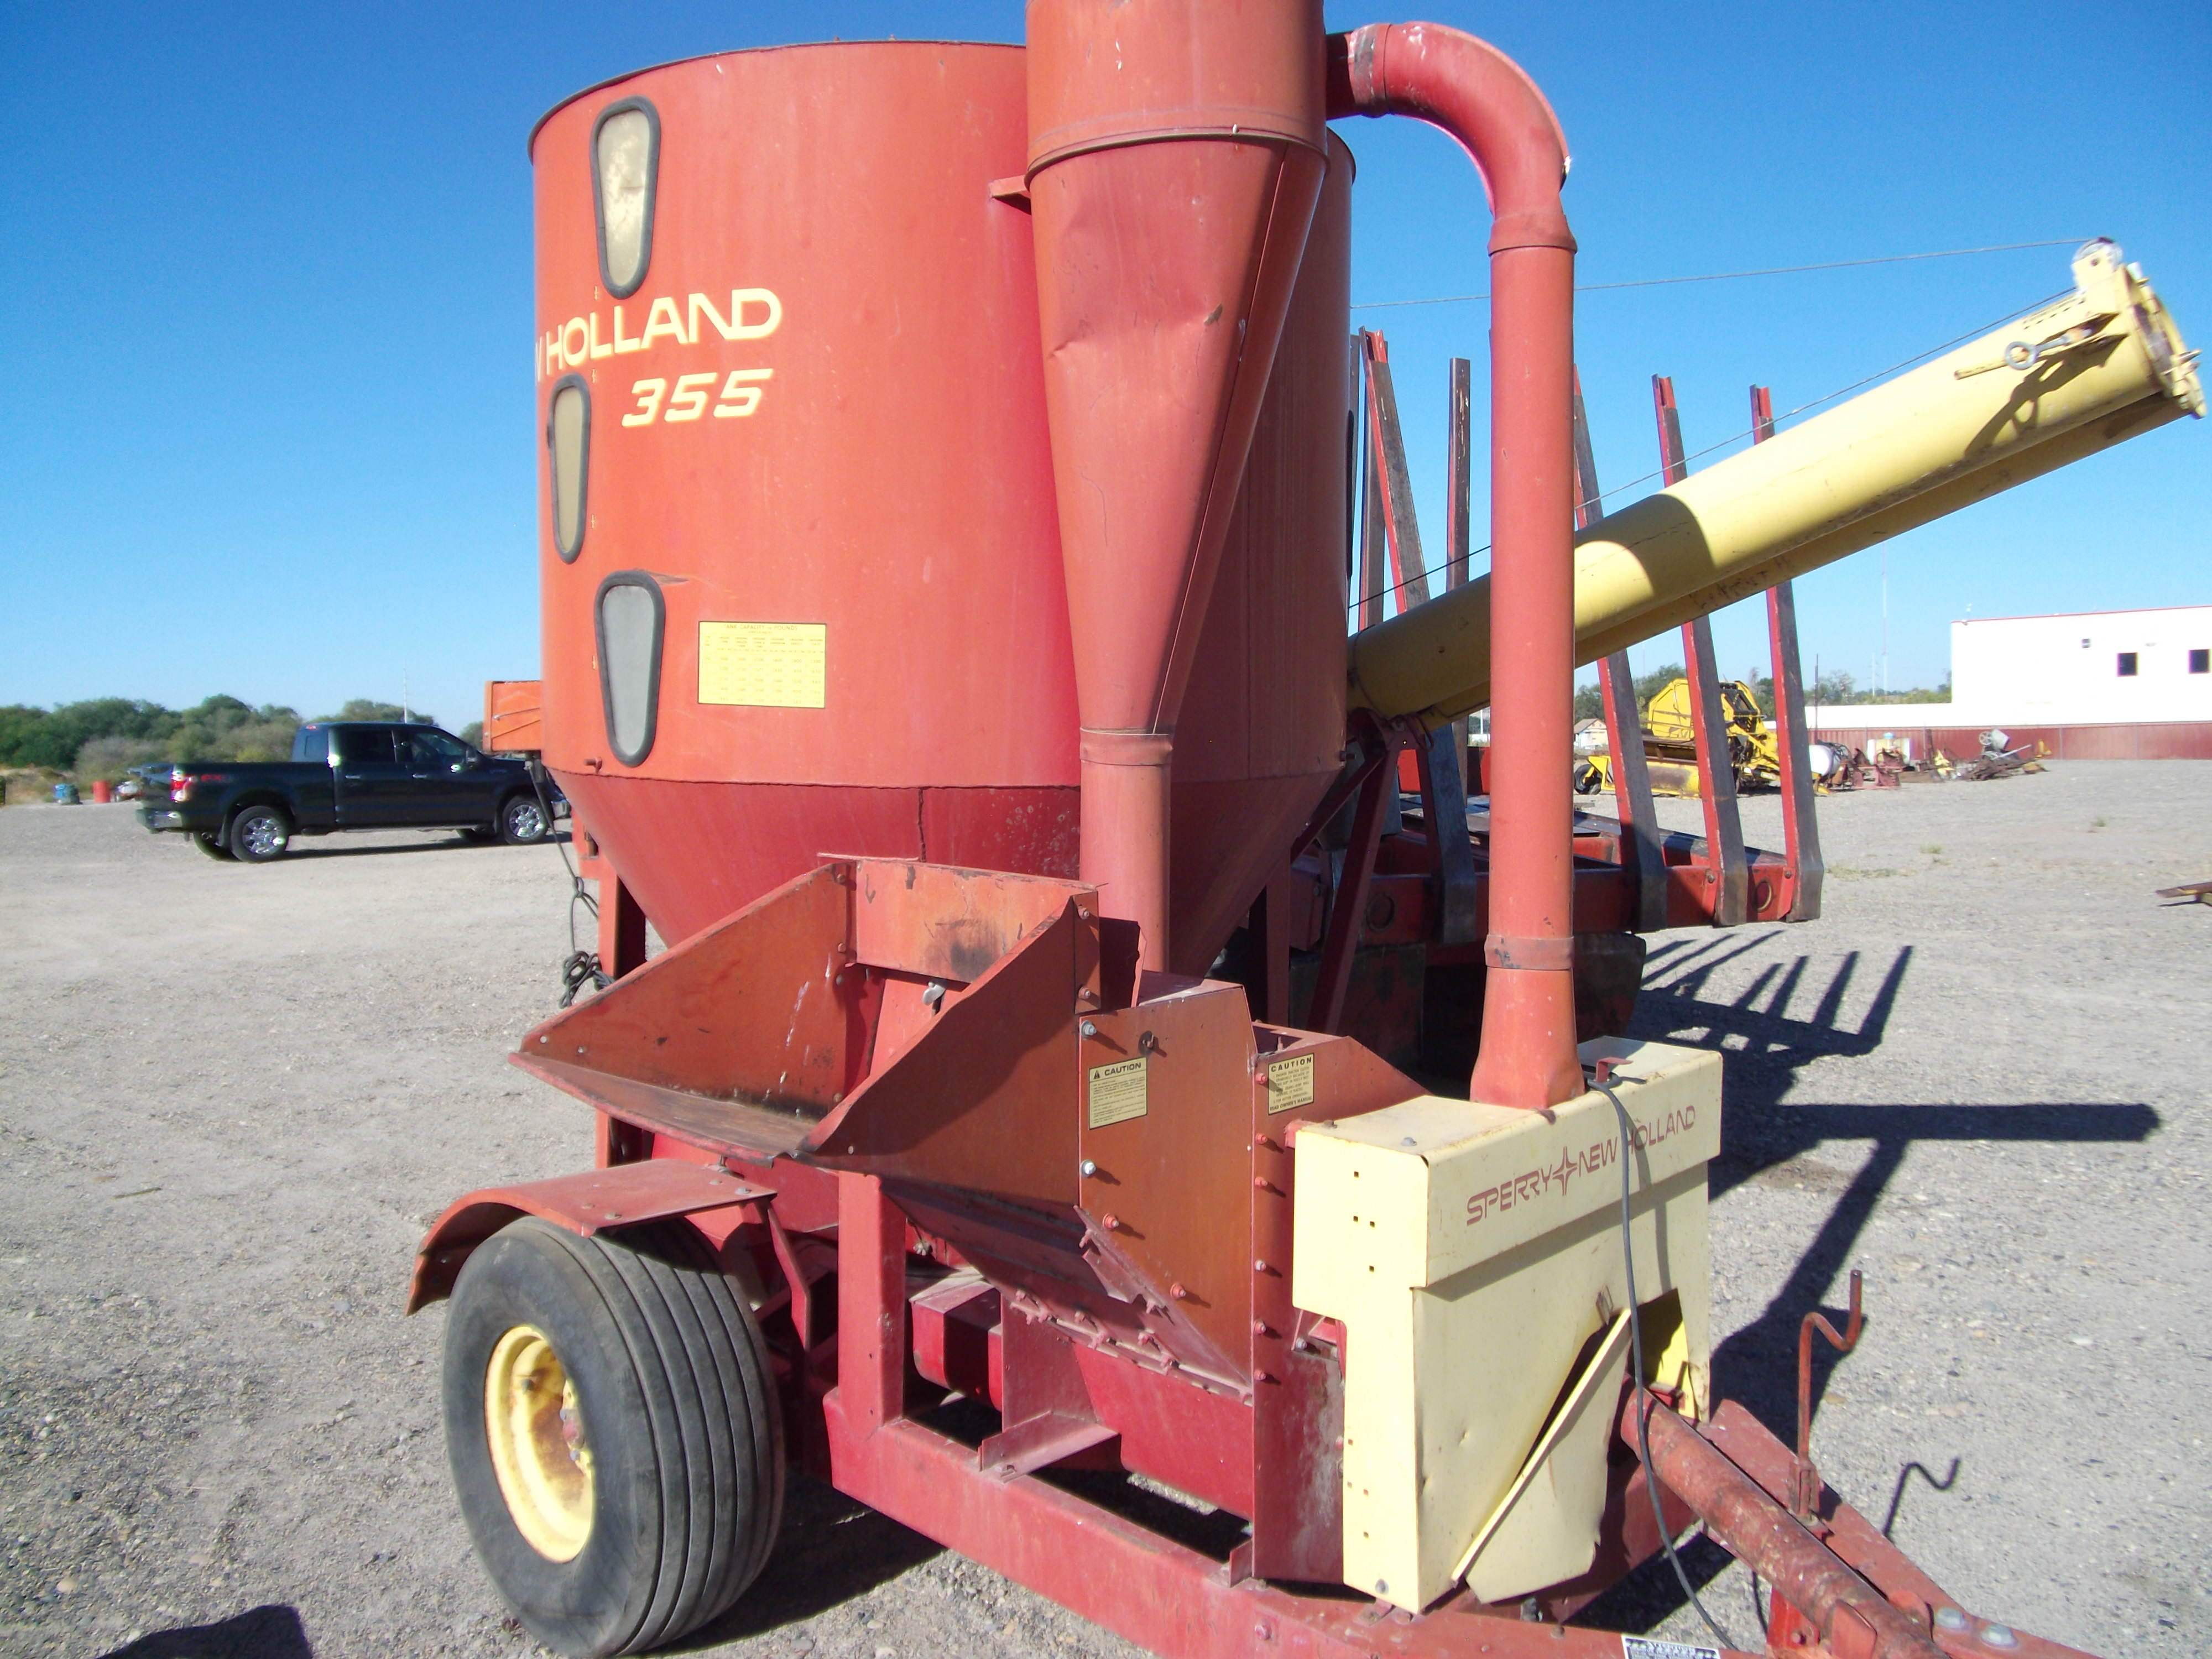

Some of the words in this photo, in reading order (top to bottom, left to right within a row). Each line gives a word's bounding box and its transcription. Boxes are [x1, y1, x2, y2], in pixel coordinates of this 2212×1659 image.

[546, 287, 782, 376] HOLLAND
[621, 368, 774, 427] 355
[1104, 1062, 1141, 1076] CAUTION
[1271, 1057, 1312, 1072] CAUTION
[1467, 1163, 1552, 1226] SPERRY
[1579, 1136, 1618, 1177] NEW
[1627, 1105, 1696, 1155] HOLLAND
